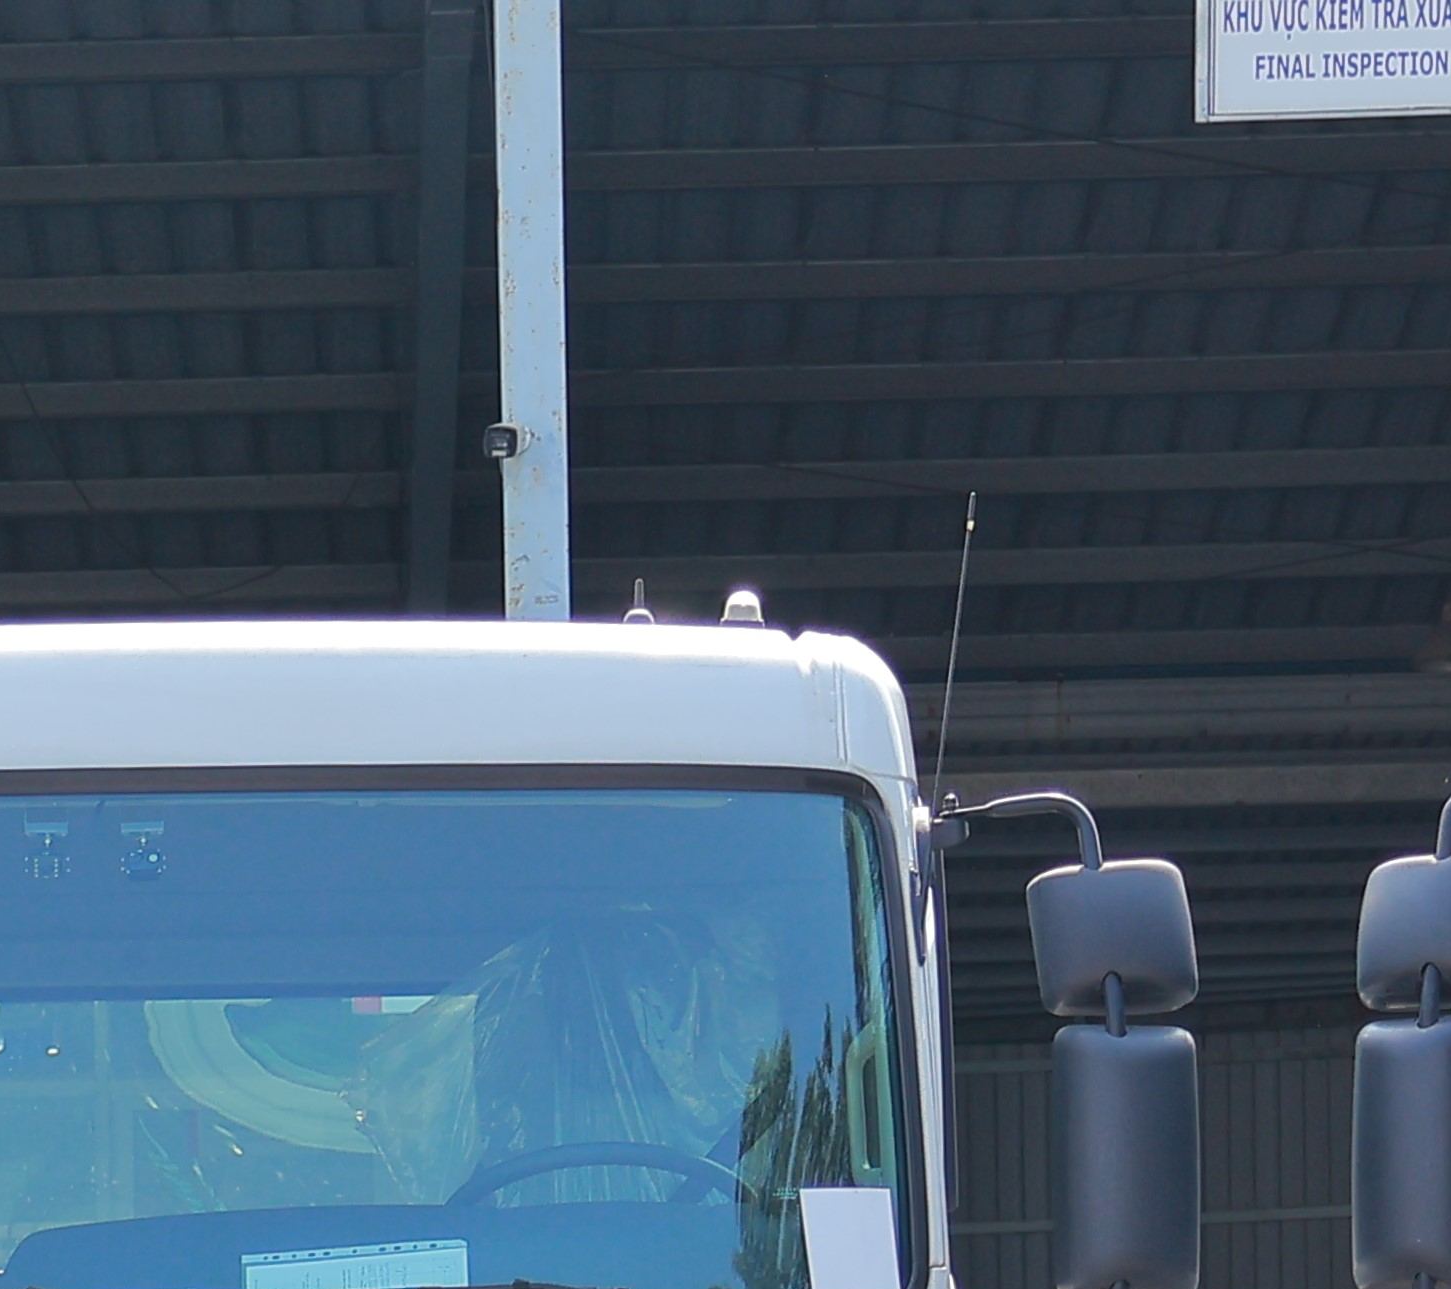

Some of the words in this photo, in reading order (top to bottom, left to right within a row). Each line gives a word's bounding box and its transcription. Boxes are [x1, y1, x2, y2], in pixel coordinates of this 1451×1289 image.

[1372, 0, 1408, 28] TRA
[1255, 53, 1316, 80] FINAL
[1322, 50, 1449, 78] INSPECTION
